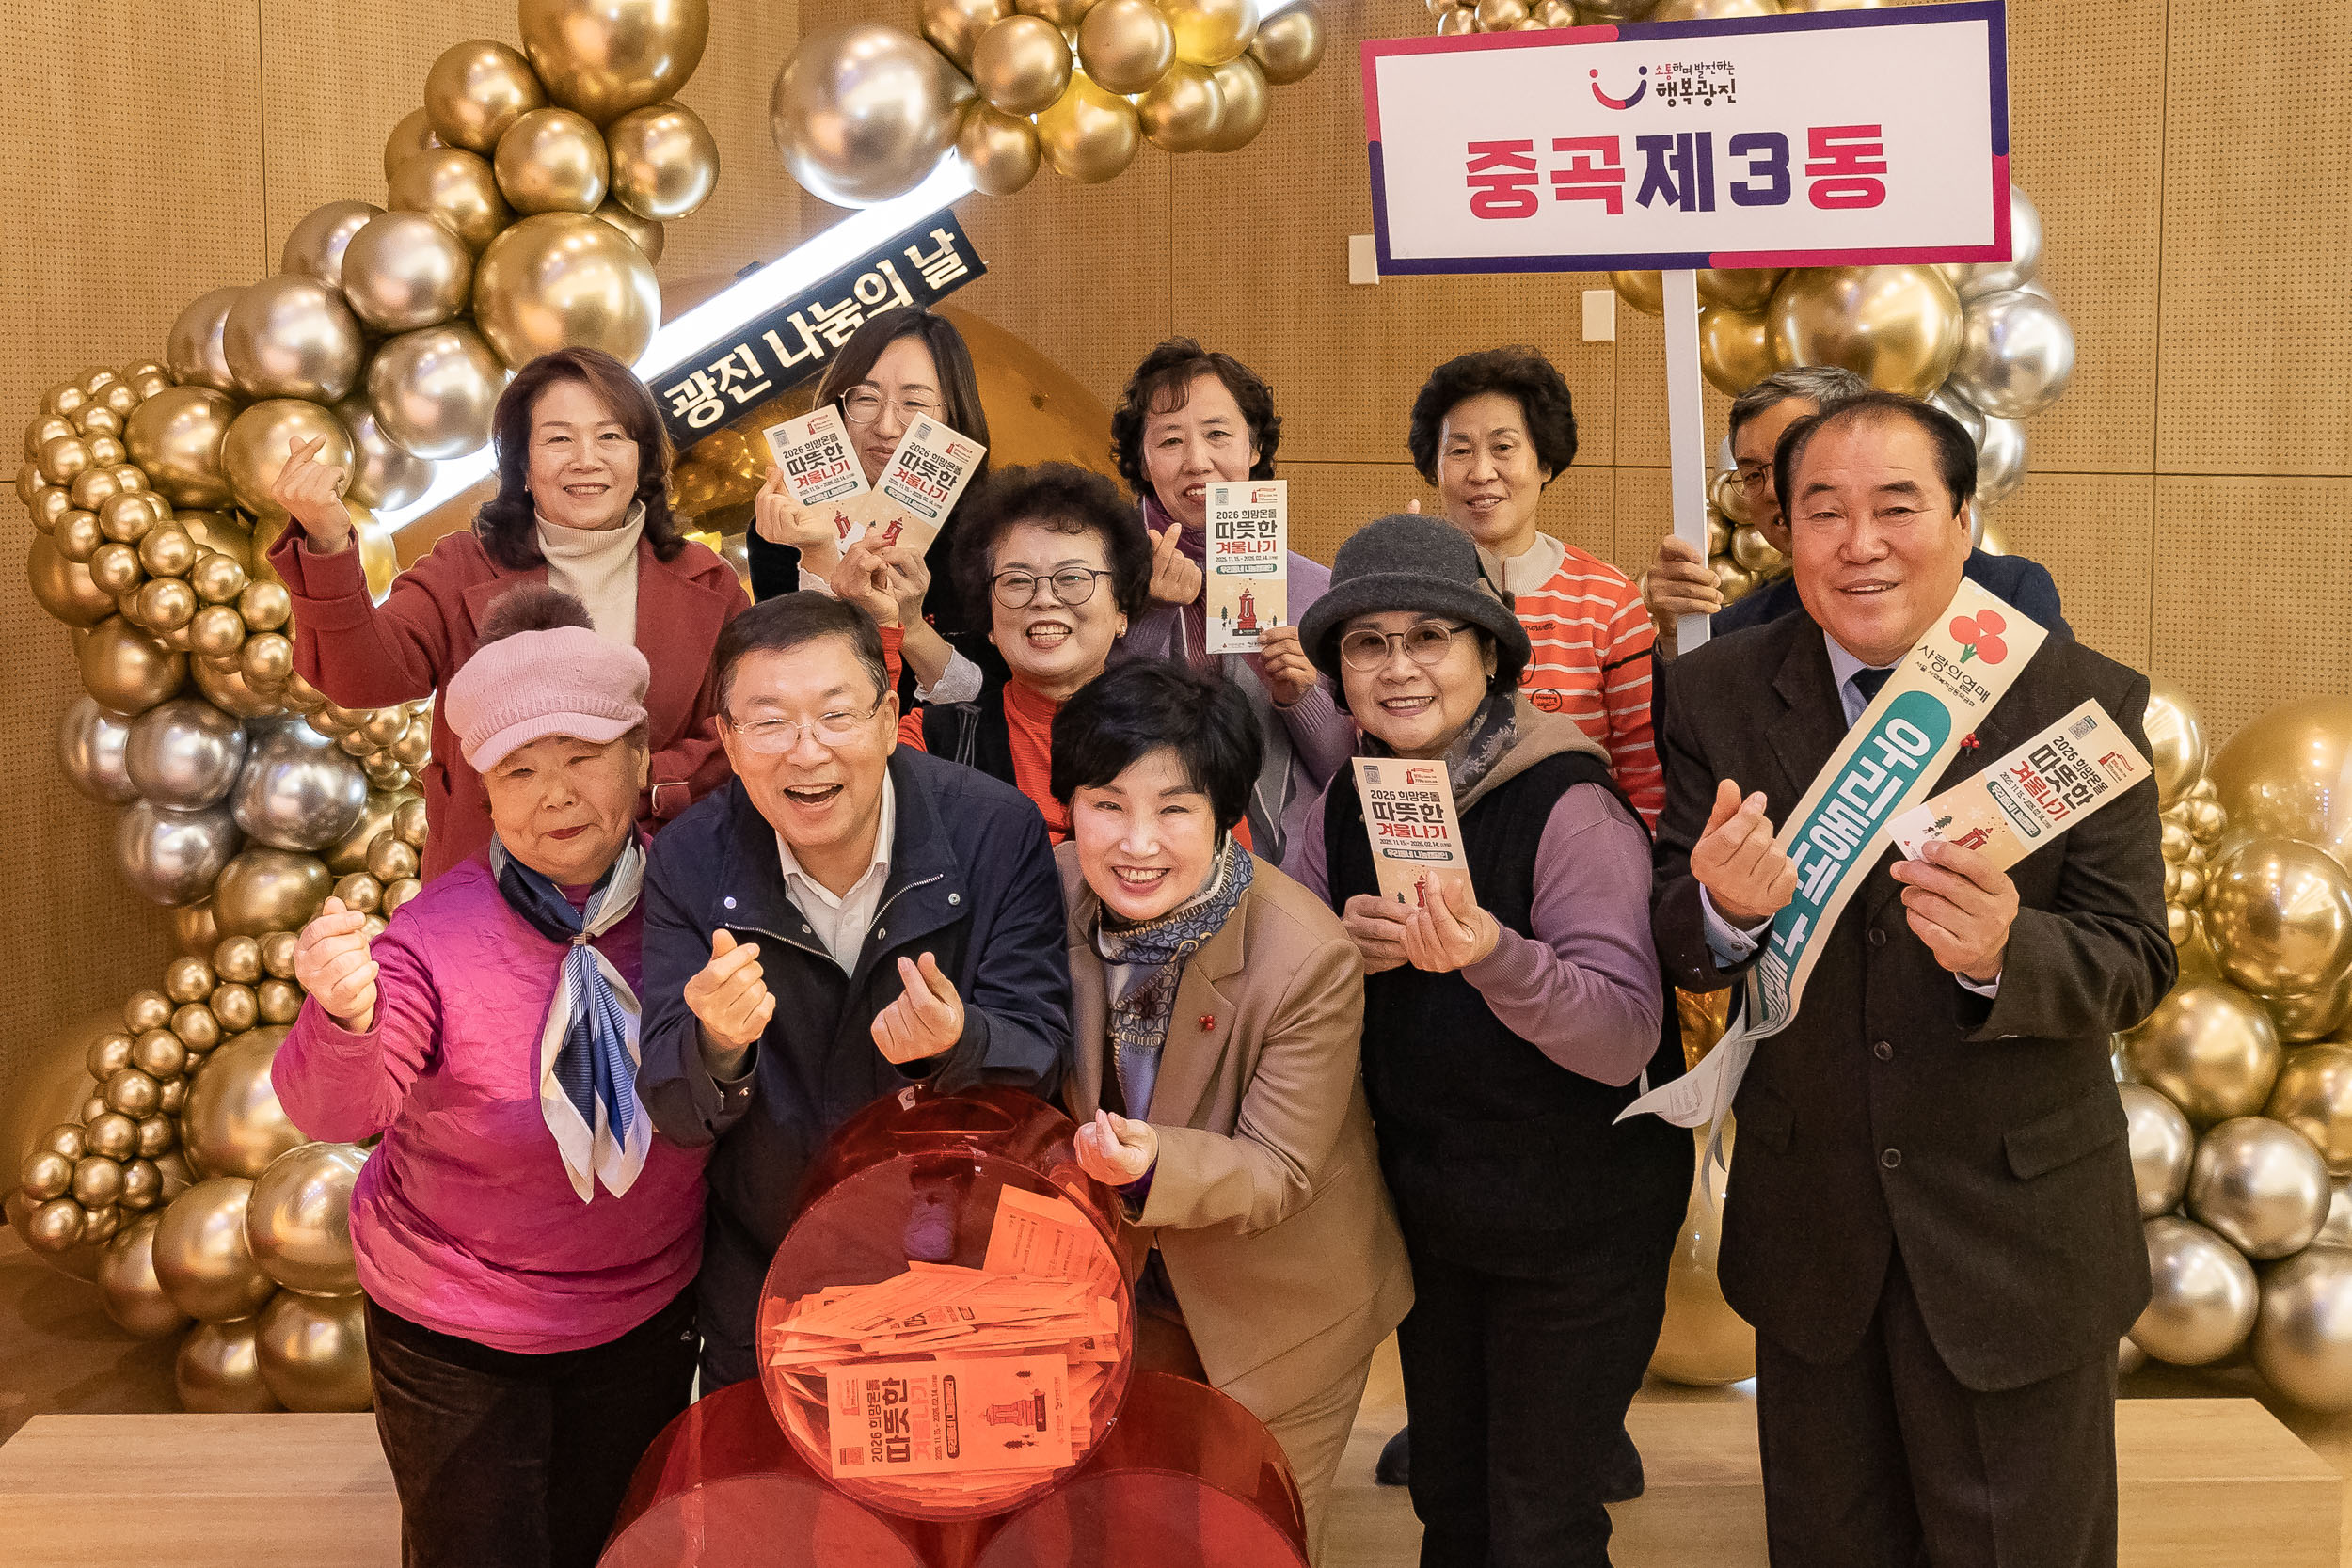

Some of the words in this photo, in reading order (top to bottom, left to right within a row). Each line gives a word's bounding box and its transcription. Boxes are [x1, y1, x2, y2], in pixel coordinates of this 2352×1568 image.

[1655, 61, 1692, 80] 소통하며
[1694, 60, 1736, 79] 발전하는
[1656, 78, 1737, 108] 행복광진
[1466, 124, 1888, 219] 중곡제3동
[663, 342, 772, 429] 광진
[762, 259, 914, 369] 나눔의
[904, 228, 968, 290] 날
[782, 445, 804, 459] 2026
[786, 442, 845, 476] 따뜻한
[908, 441, 930, 458] 2026
[793, 459, 850, 489] 겨울나기
[892, 466, 948, 503] 겨울나기
[898, 450, 957, 492] 따뜻한
[1216, 511, 1239, 519] 2026
[1216, 519, 1278, 539] 따뜻한
[1216, 540, 1276, 554] 겨울나기
[1915, 660, 1928, 673] 서울
[1917, 644, 1990, 703] 사랑의열매
[2027, 742, 2094, 810] 따뜻한
[2052, 735, 2078, 762] 2026
[2072, 757, 2108, 796] 희망온돌
[1370, 789, 1395, 800] 2026
[1398, 791, 1440, 802] 희망온
[2009, 760, 2070, 821] 겨울나기
[1372, 801, 1444, 823] 따뜻한
[1787, 718, 1931, 906] 우리동네
[1376, 823, 1447, 839] 겨울나기
[866, 1380, 882, 1429] 희망온돌
[882, 1378, 911, 1463] 따뜻한
[870, 1432, 883, 1463] 2026
